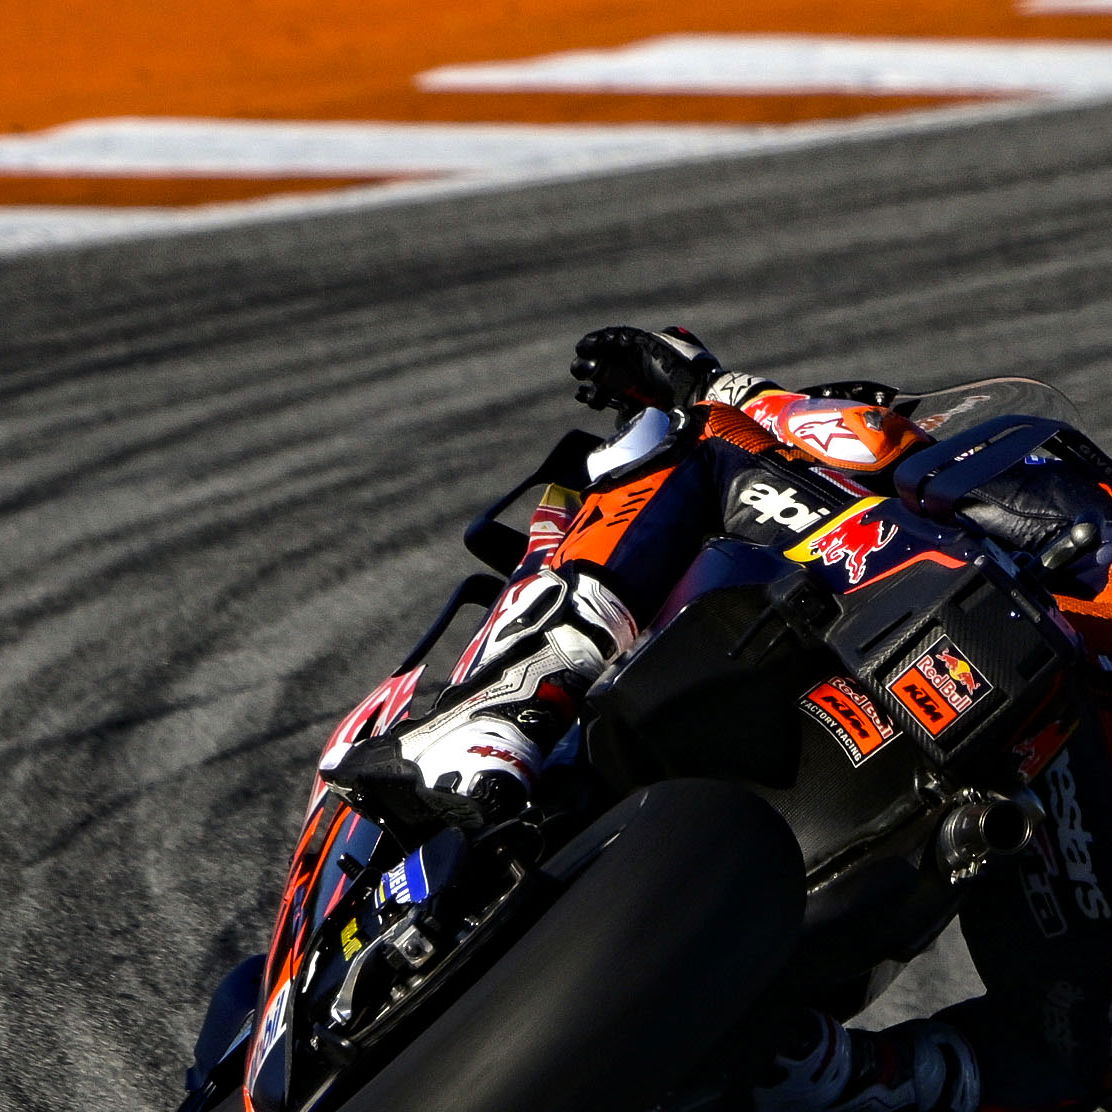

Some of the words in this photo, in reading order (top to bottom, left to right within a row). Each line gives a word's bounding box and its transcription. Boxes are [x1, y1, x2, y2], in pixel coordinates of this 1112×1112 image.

[902, 684, 943, 722] KTM
[916, 655, 950, 688] Red
[940, 679, 973, 713] Bull
[800, 699, 838, 728] FACTORY
[835, 727, 862, 762] RACING
[821, 696, 870, 738] KTM
